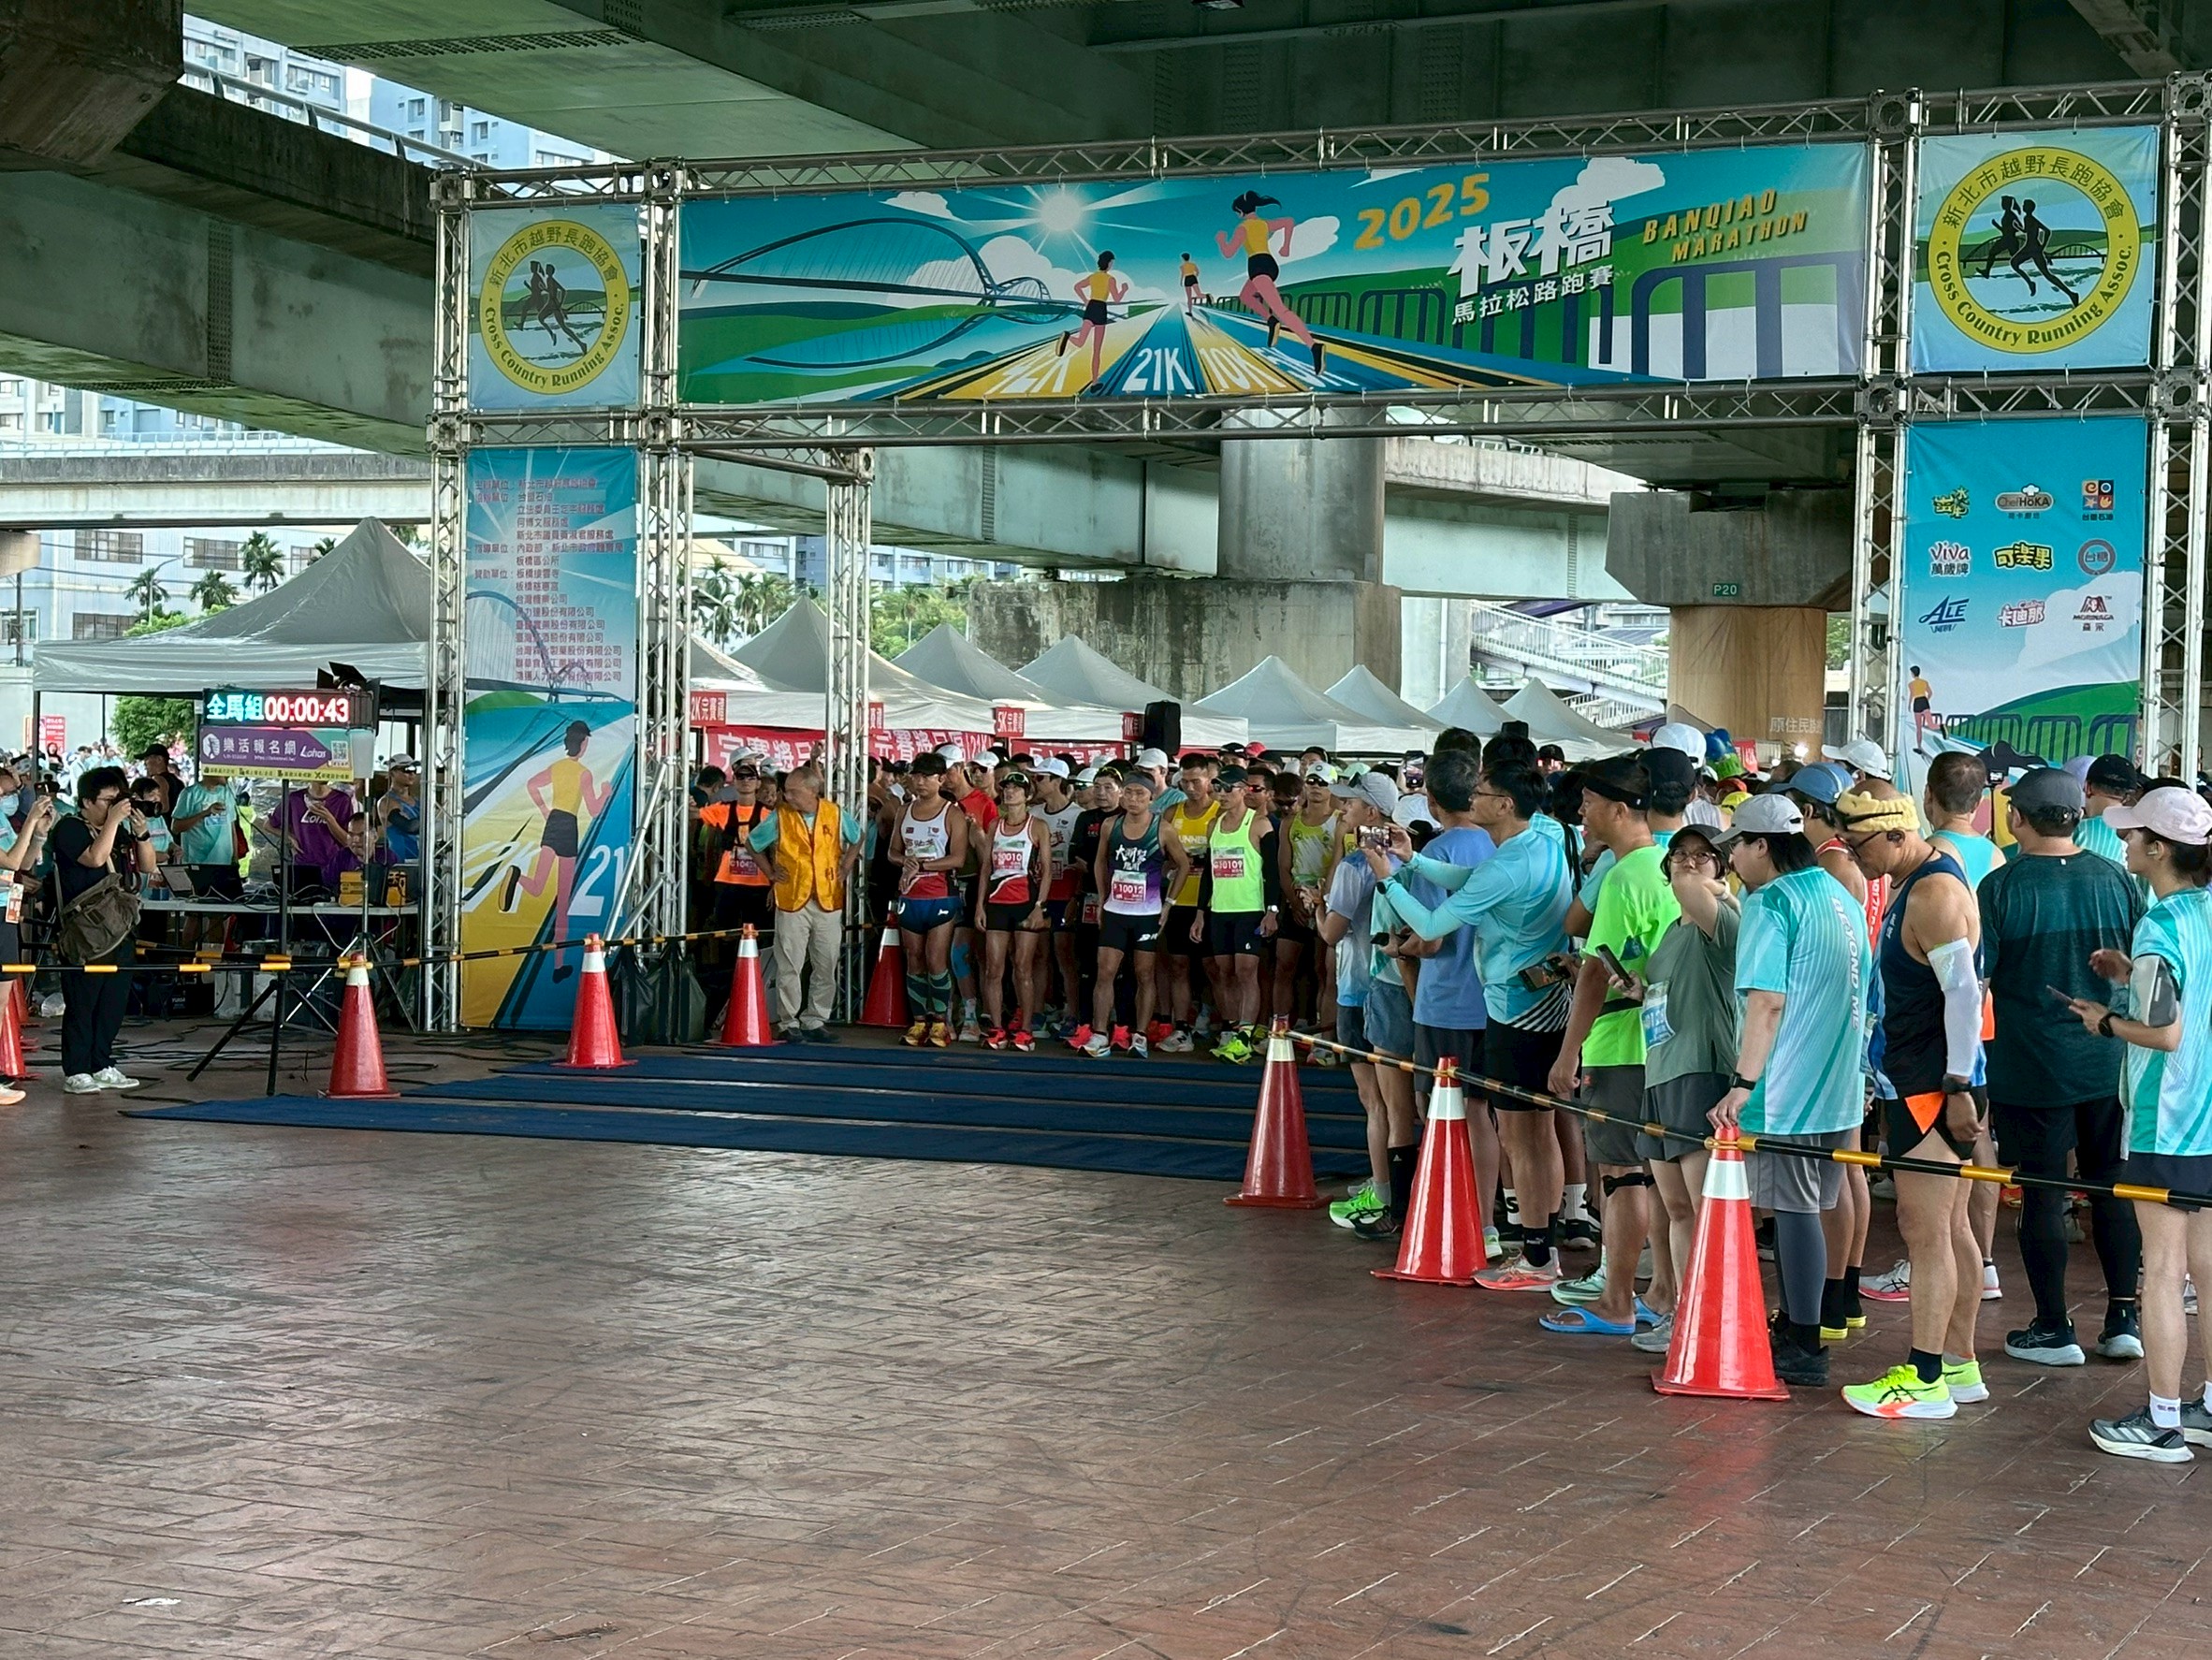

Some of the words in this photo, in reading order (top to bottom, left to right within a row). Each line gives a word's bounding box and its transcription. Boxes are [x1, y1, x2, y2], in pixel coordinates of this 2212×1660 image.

[1354, 172, 1491, 251] 2025
[1643, 188, 1776, 244] BANQIAO
[1942, 154, 2125, 229] 新北市越野長跑協會
[488, 226, 618, 288] 新北市越野長跑協會
[1447, 200, 1615, 299] 板橋
[1672, 211, 1808, 263] MARATHON
[1451, 264, 1615, 326] 馬拉松路跑賽
[1936, 250, 1960, 301] Cross
[1957, 301, 2022, 347] Country
[2027, 302, 2103, 345] Running
[2099, 245, 2133, 304] Assoc.
[485, 307, 502, 350] Cross
[501, 349, 548, 389] Country
[551, 353, 605, 387] Running
[603, 302, 625, 354] Assoc.
[1122, 347, 1196, 393] 21K
[1199, 347, 1288, 390] 10K
[516, 556, 560, 567] 板橋區公所
[1713, 584, 1738, 596] P20
[207, 693, 265, 722] 全馬組
[265, 696, 350, 723] 00:00:43
[223, 737, 297, 755] 樂活報名網
[1831, 896, 1859, 990] BEYOND
